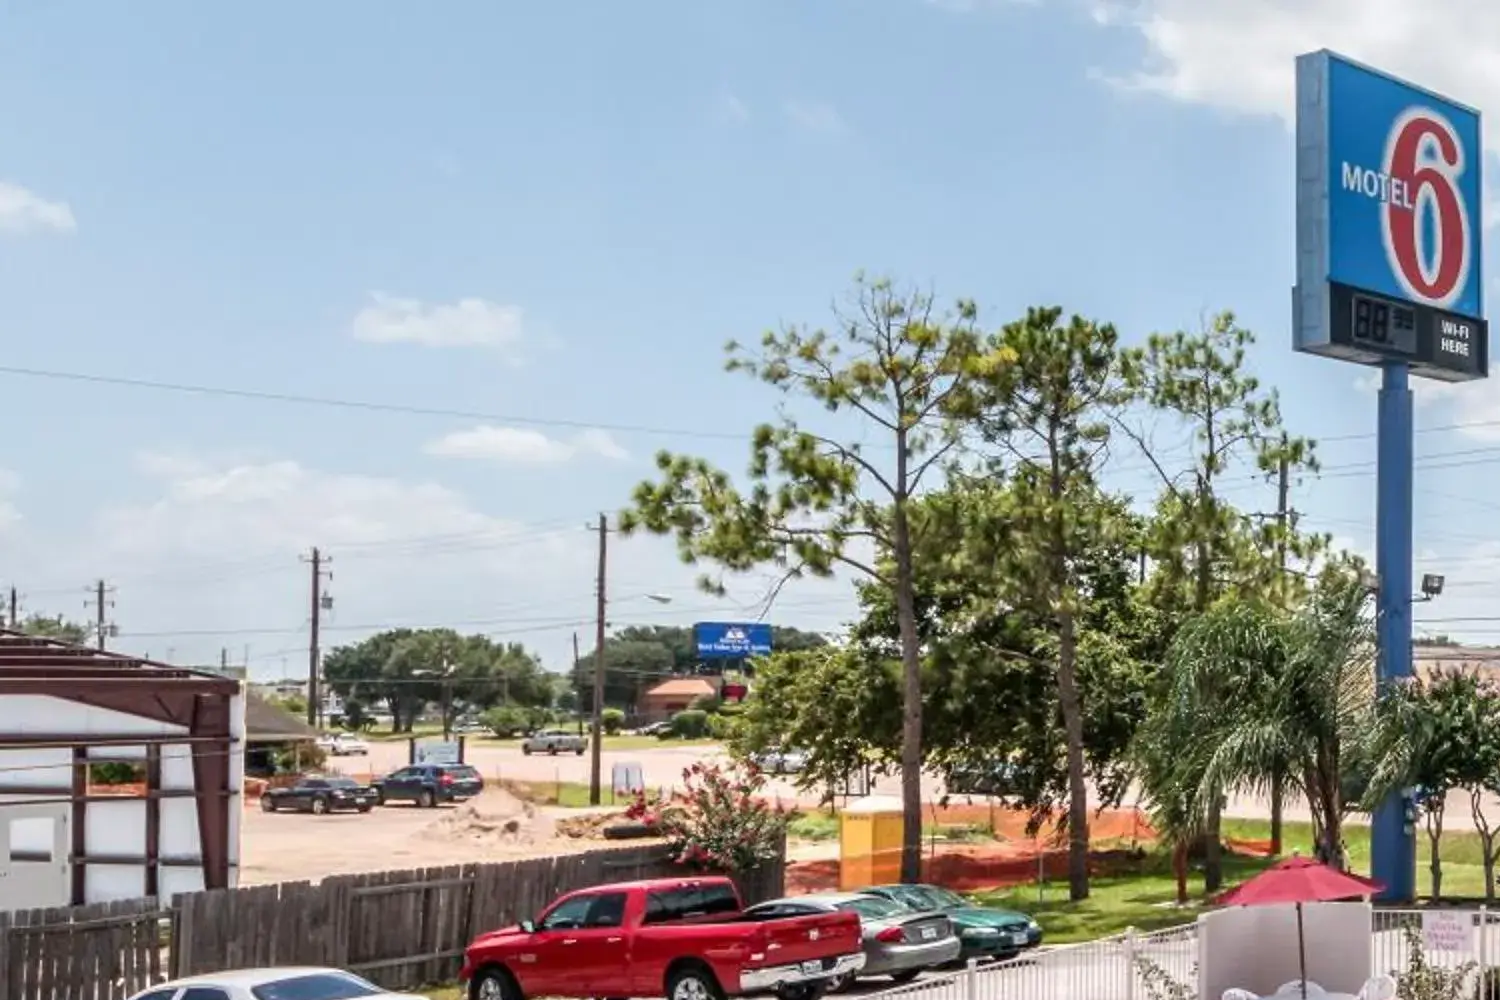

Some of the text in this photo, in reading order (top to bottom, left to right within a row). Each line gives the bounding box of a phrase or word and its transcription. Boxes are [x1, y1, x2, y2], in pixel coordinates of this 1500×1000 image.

[1341, 109, 1468, 303] MOTEL 6
[1441, 319, 1469, 340] WI-FI
[1441, 337, 1470, 357] HERE
